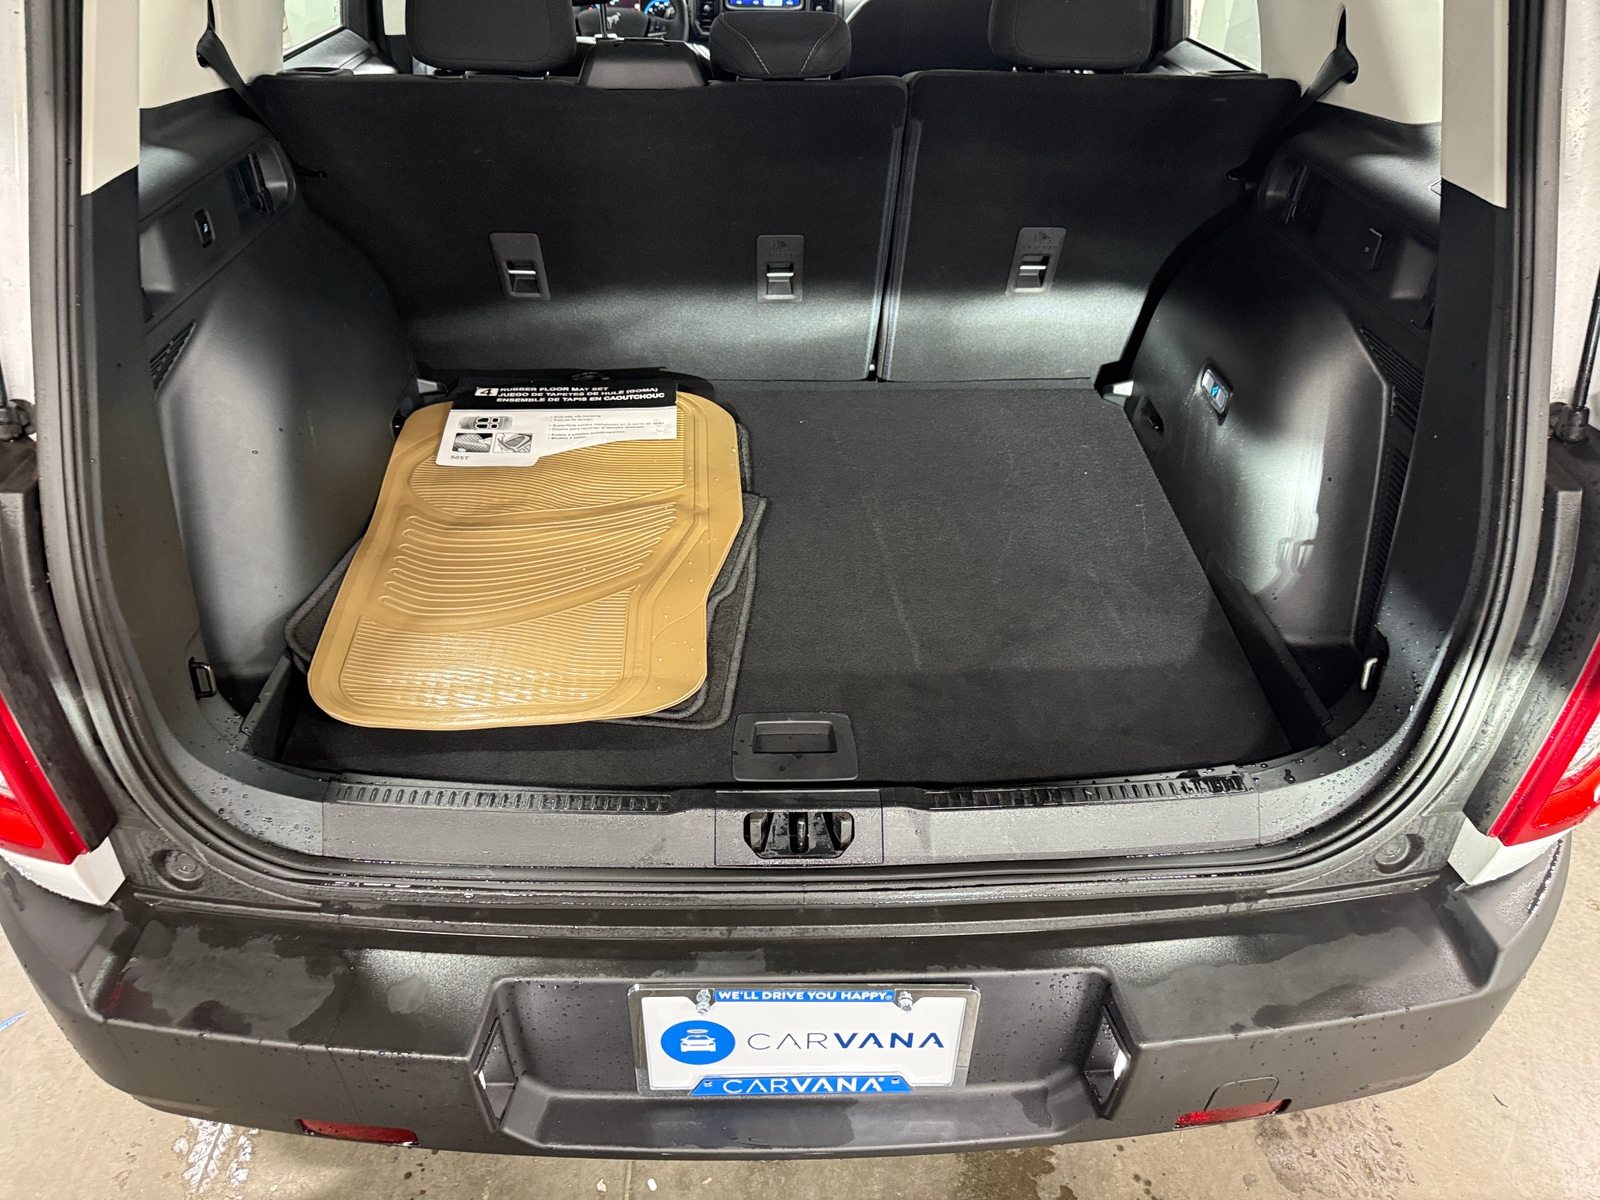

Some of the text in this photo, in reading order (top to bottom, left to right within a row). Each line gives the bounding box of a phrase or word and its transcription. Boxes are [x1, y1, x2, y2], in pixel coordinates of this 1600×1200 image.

[626, 387, 659, 395] (GOMA)
[603, 392, 665, 401] CAOUTCHOUC
[718, 990, 759, 1000] WE'LL
[761, 990, 805, 1000] DRIVE
[807, 990, 838, 1000] YOU
[747, 1031, 945, 1051] CARVANA
[722, 1076, 883, 1094] CARVANA
